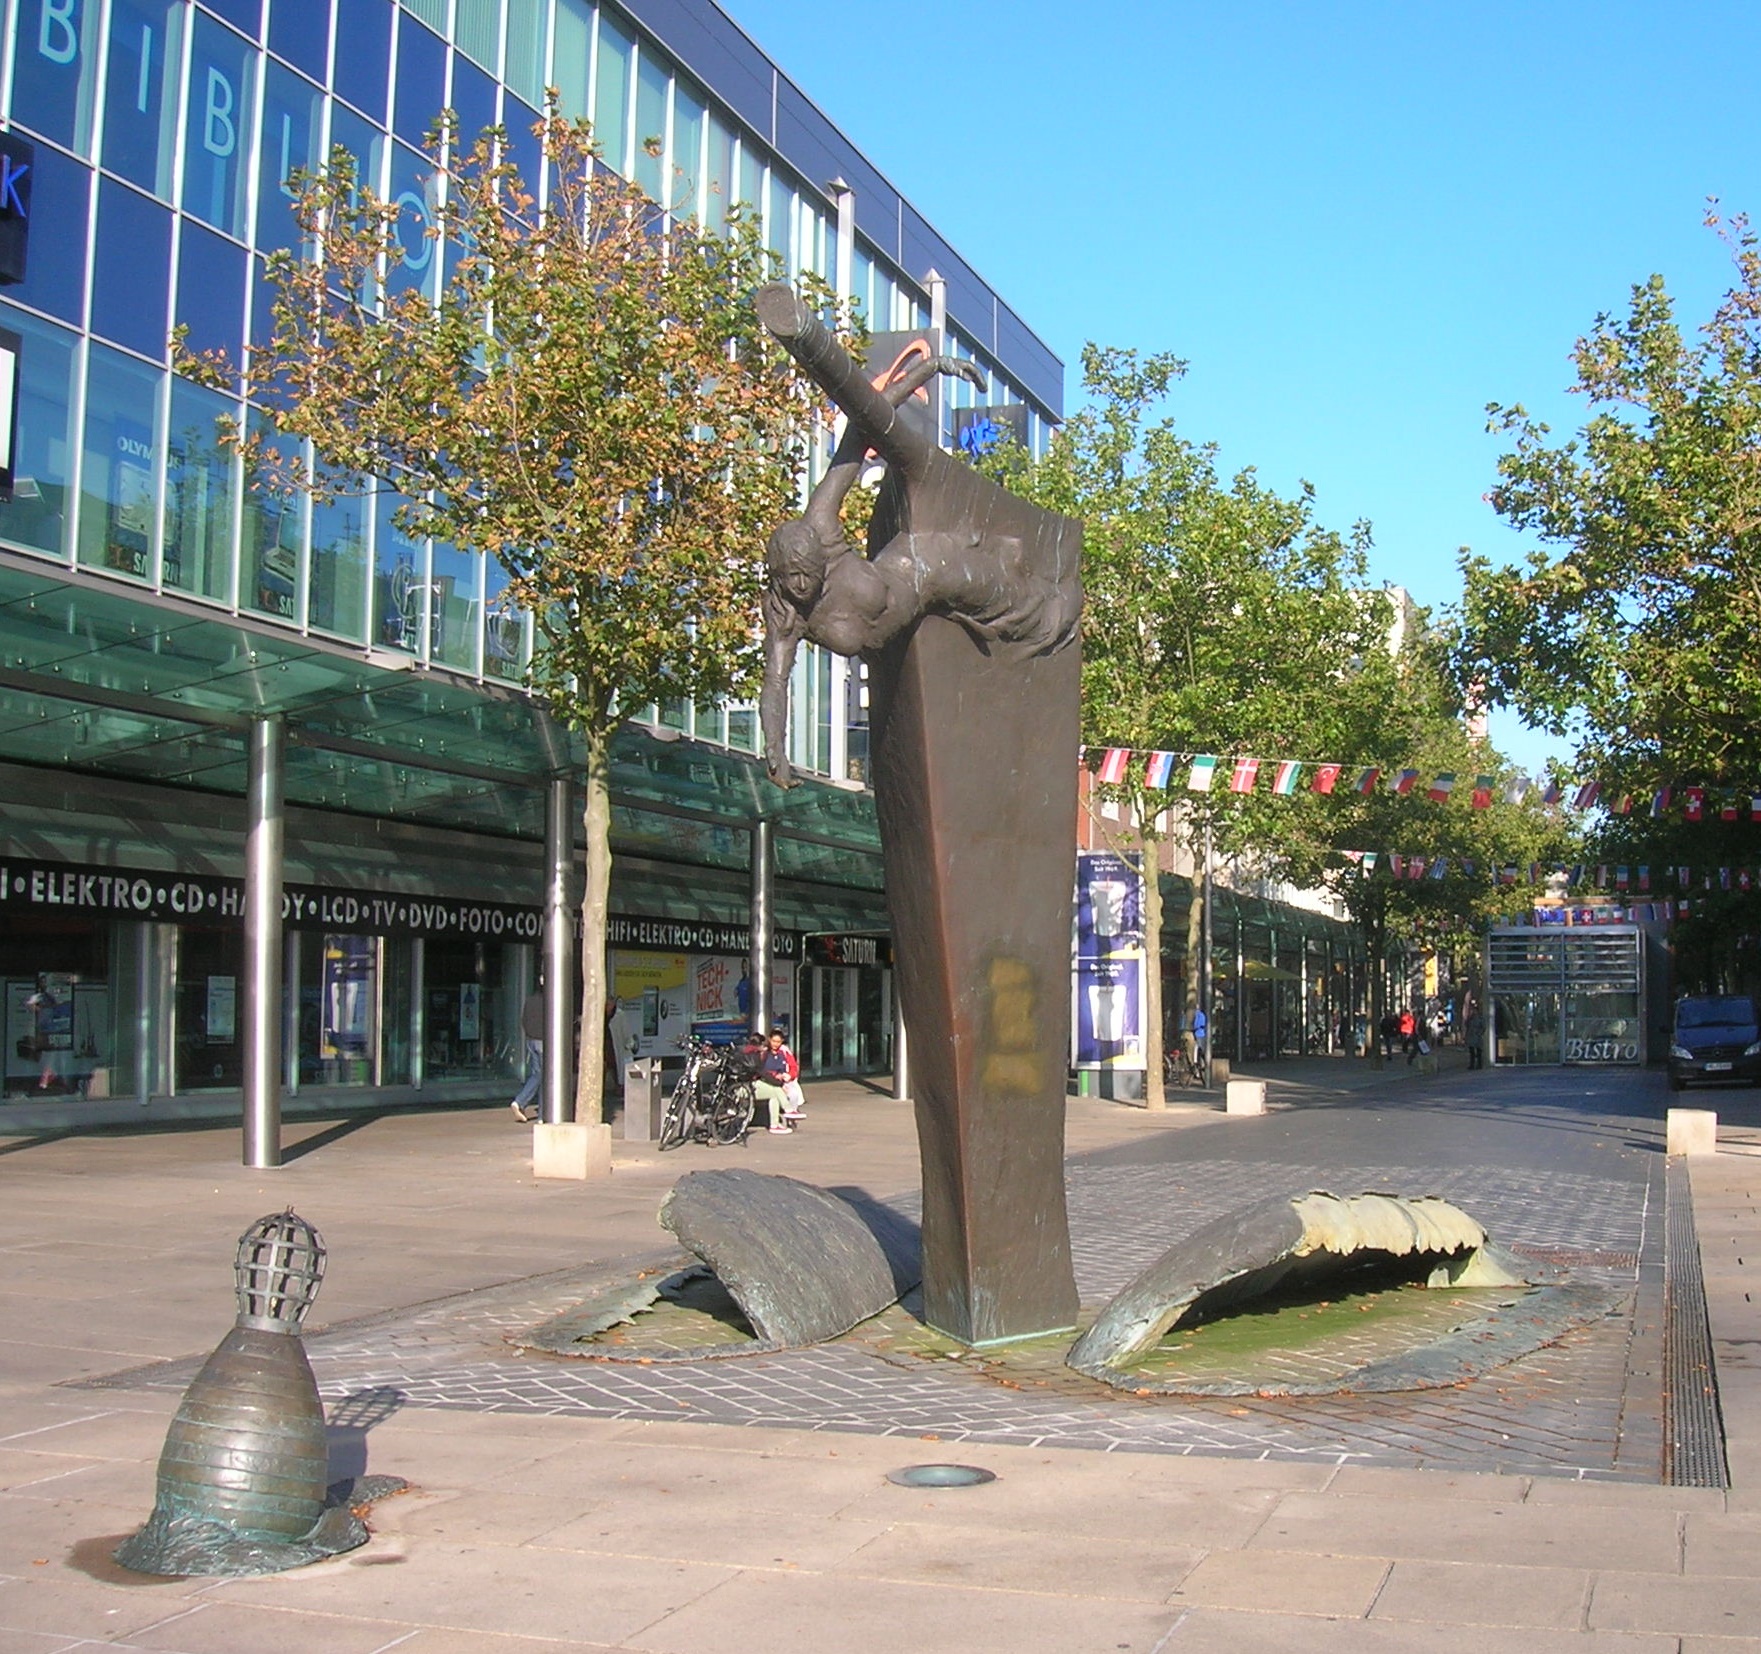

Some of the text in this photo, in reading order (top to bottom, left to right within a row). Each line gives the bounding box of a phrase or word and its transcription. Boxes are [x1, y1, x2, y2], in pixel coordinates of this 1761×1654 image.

[117, 436, 182, 470] OLYMUS
[133, 551, 180, 584] SARN
[31, 870, 152, 911] ELEKTRO
[170, 882, 204, 913] CD
[221, 887, 306, 921] HDY
[322, 895, 359, 924] LCD
[372, 899, 397, 928] TV
[409, 903, 448, 930] DVD
[459, 907, 505, 935] FOTO
[640, 922, 690, 947] ELEKTRO
[698, 927, 713, 947] CD
[842, 937, 877, 965] SATURN
[696, 985, 723, 1012] NICK
[1566, 1038, 1638, 1061] Bistro
